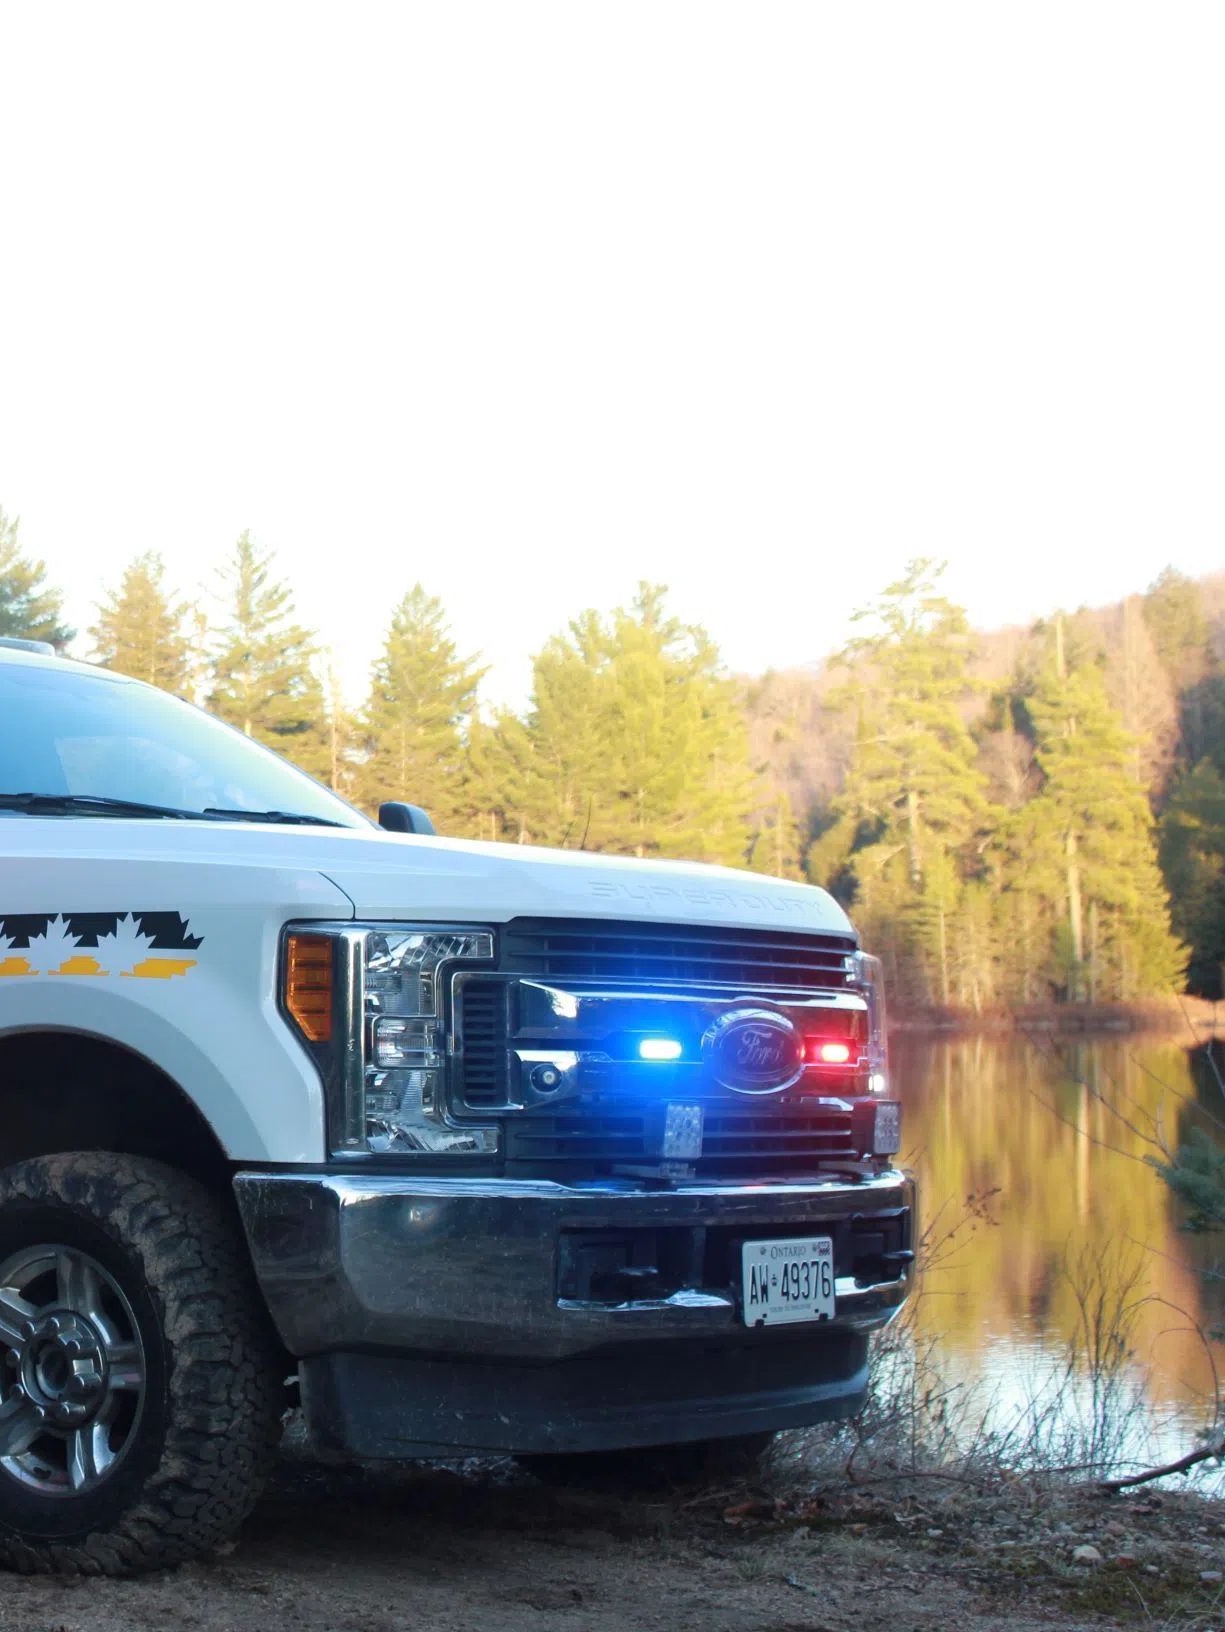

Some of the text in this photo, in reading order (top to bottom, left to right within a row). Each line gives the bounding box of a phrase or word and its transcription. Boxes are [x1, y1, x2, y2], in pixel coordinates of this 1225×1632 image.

[736, 1029, 785, 1065] Ford
[750, 1260, 831, 1305] AW 49376
